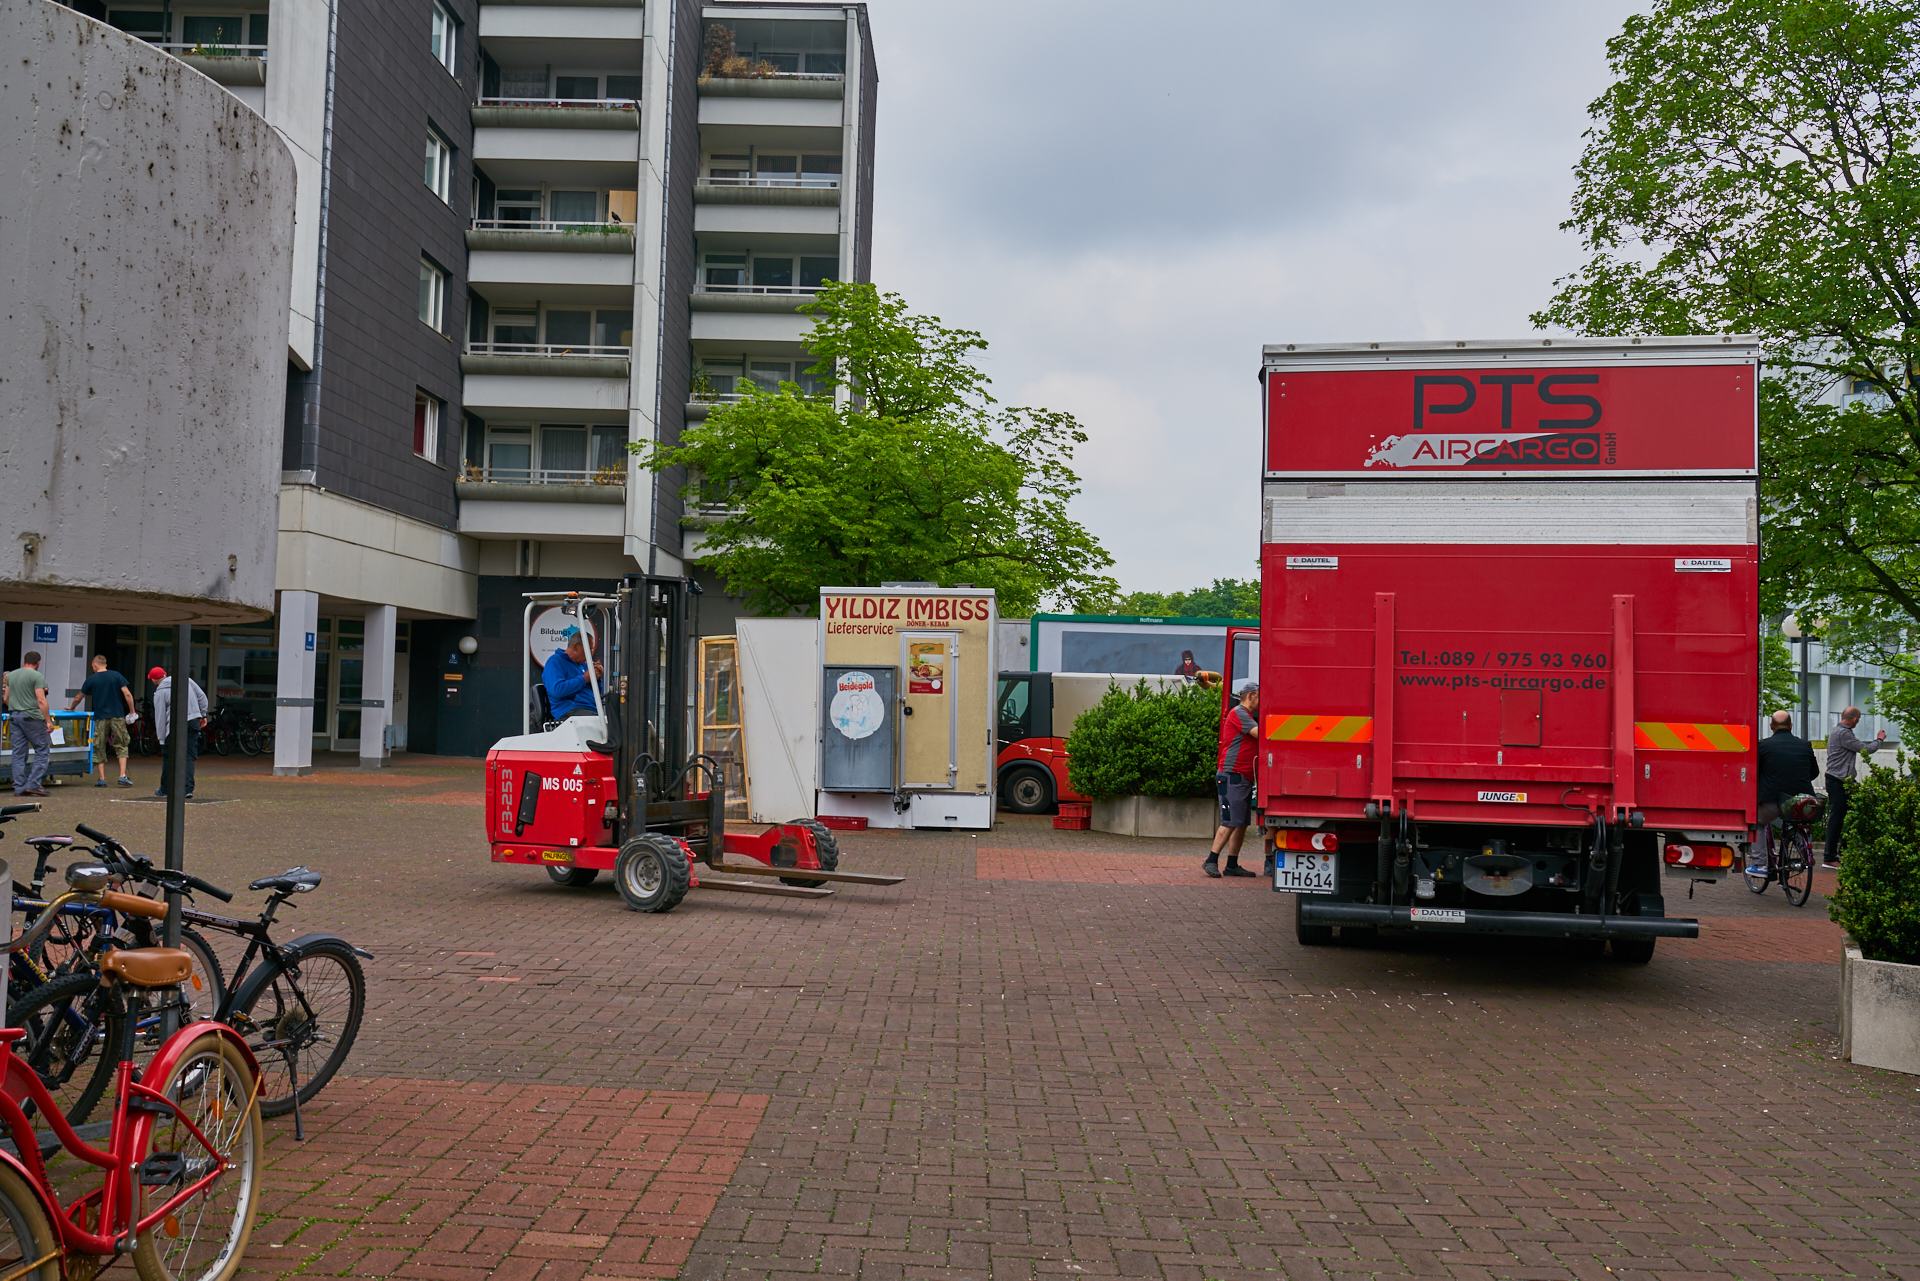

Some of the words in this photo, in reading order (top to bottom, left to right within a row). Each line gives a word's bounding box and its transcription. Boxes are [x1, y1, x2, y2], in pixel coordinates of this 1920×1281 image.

[1413, 374, 1602, 429] PTS
[1412, 438, 1599, 460] AIRCARGO
[1604, 432, 1617, 465] GmbH
[825, 598, 901, 620] YILDIZ
[906, 598, 989, 621] IMBISS
[43, 626, 52, 634] 10
[827, 621, 894, 635] Lieferservice
[906, 618, 927, 627] DÖNER
[540, 627, 572, 636] Bildungs
[1497, 652, 1533, 667] 975
[1539, 653, 1564, 668] 93
[1570, 653, 1607, 668] 960
[838, 680, 873, 692] Heidegold
[1399, 672, 1606, 693] www.pts-aircargo.de
[542, 777, 560, 790] MS
[562, 778, 583, 792] 005
[501, 768, 513, 834] F3-253
[1479, 792, 1516, 801] JUNGE
[1295, 854, 1316, 870] FS
[1281, 871, 1333, 889] TH614
[1421, 909, 1466, 918] DAUTEL
